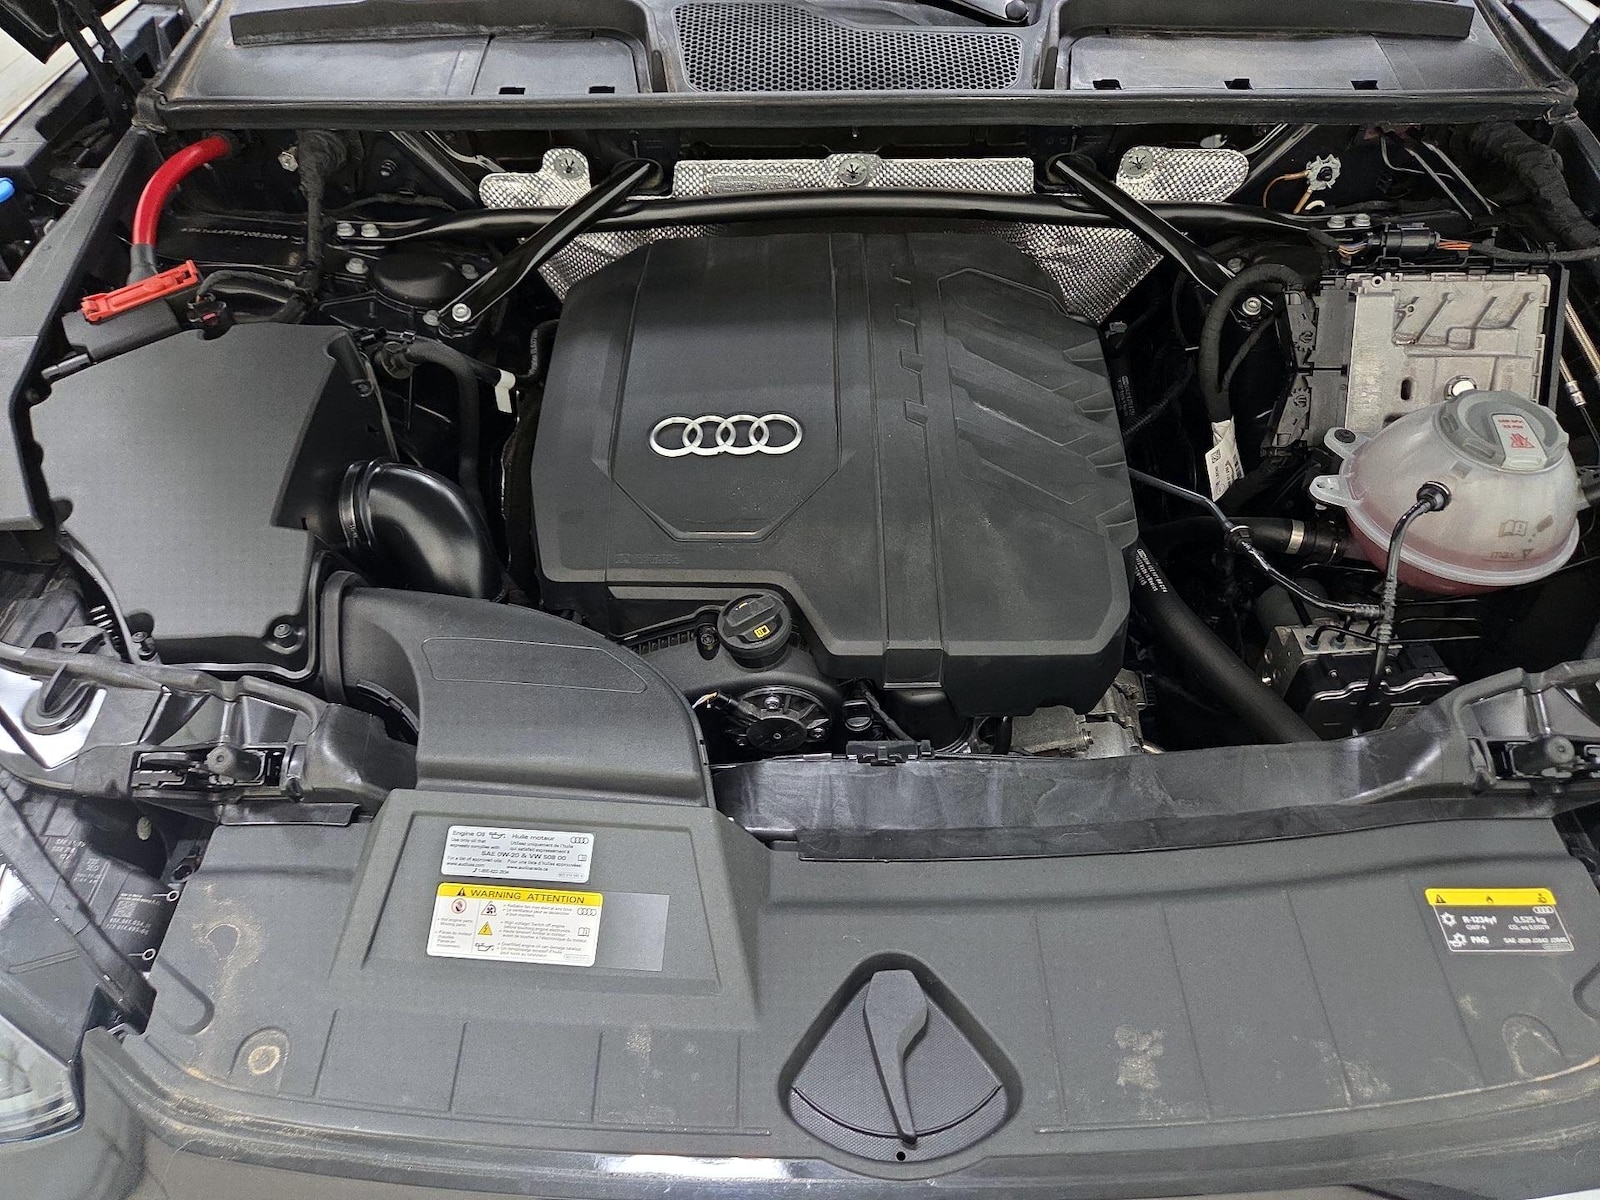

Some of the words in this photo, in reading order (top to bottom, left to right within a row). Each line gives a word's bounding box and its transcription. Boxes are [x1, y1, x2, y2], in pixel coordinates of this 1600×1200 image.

[470, 889, 521, 900] WARNING
[527, 893, 585, 903] ATTENTION
[1462, 915, 1497, 925] R-1234yf
[1535, 916, 1547, 924] kg
[1470, 936, 1489, 944] PAG
